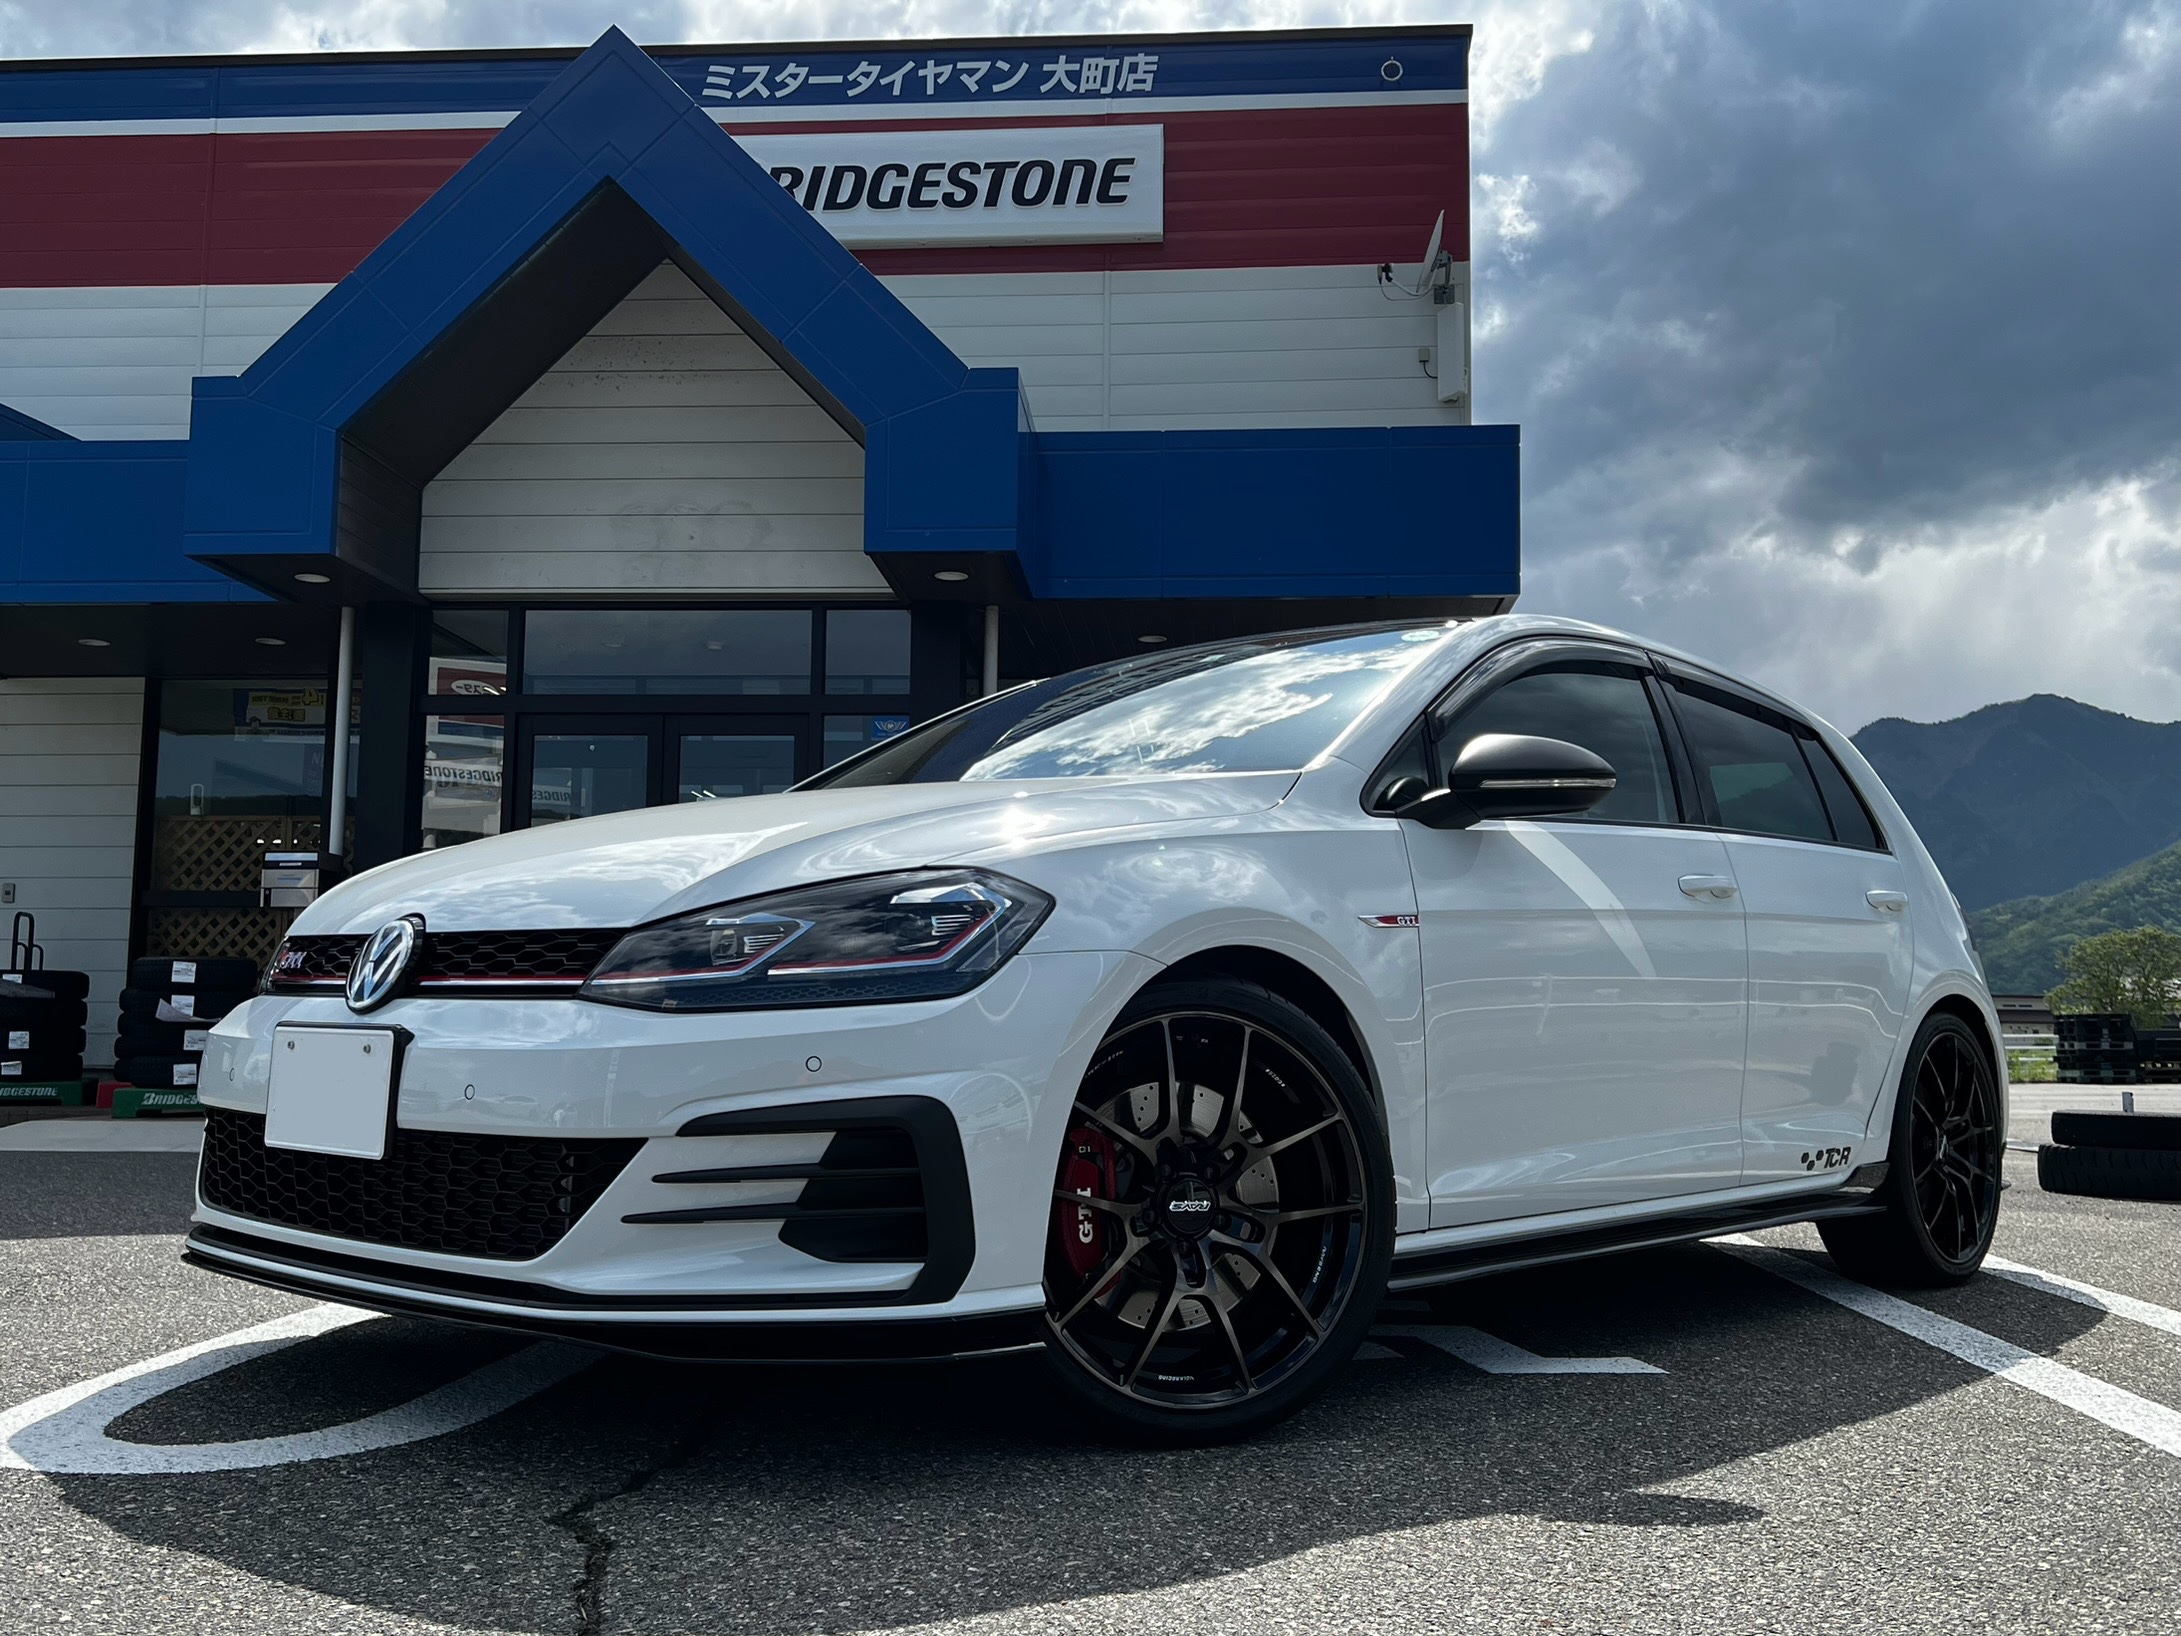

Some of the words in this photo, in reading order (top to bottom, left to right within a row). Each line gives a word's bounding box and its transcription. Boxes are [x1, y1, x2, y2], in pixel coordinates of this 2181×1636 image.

[701, 60, 1030, 100] ミスタータイヤマン
[1040, 52, 1159, 94] 大町店
[769, 157, 1136, 211] RIDGESTONE
[1396, 916, 1416, 926] GTI
[0, 1087, 58, 1096] IDGESTONE
[141, 1092, 200, 1105] BRIDGES
[1824, 1146, 1852, 1169] TCR
